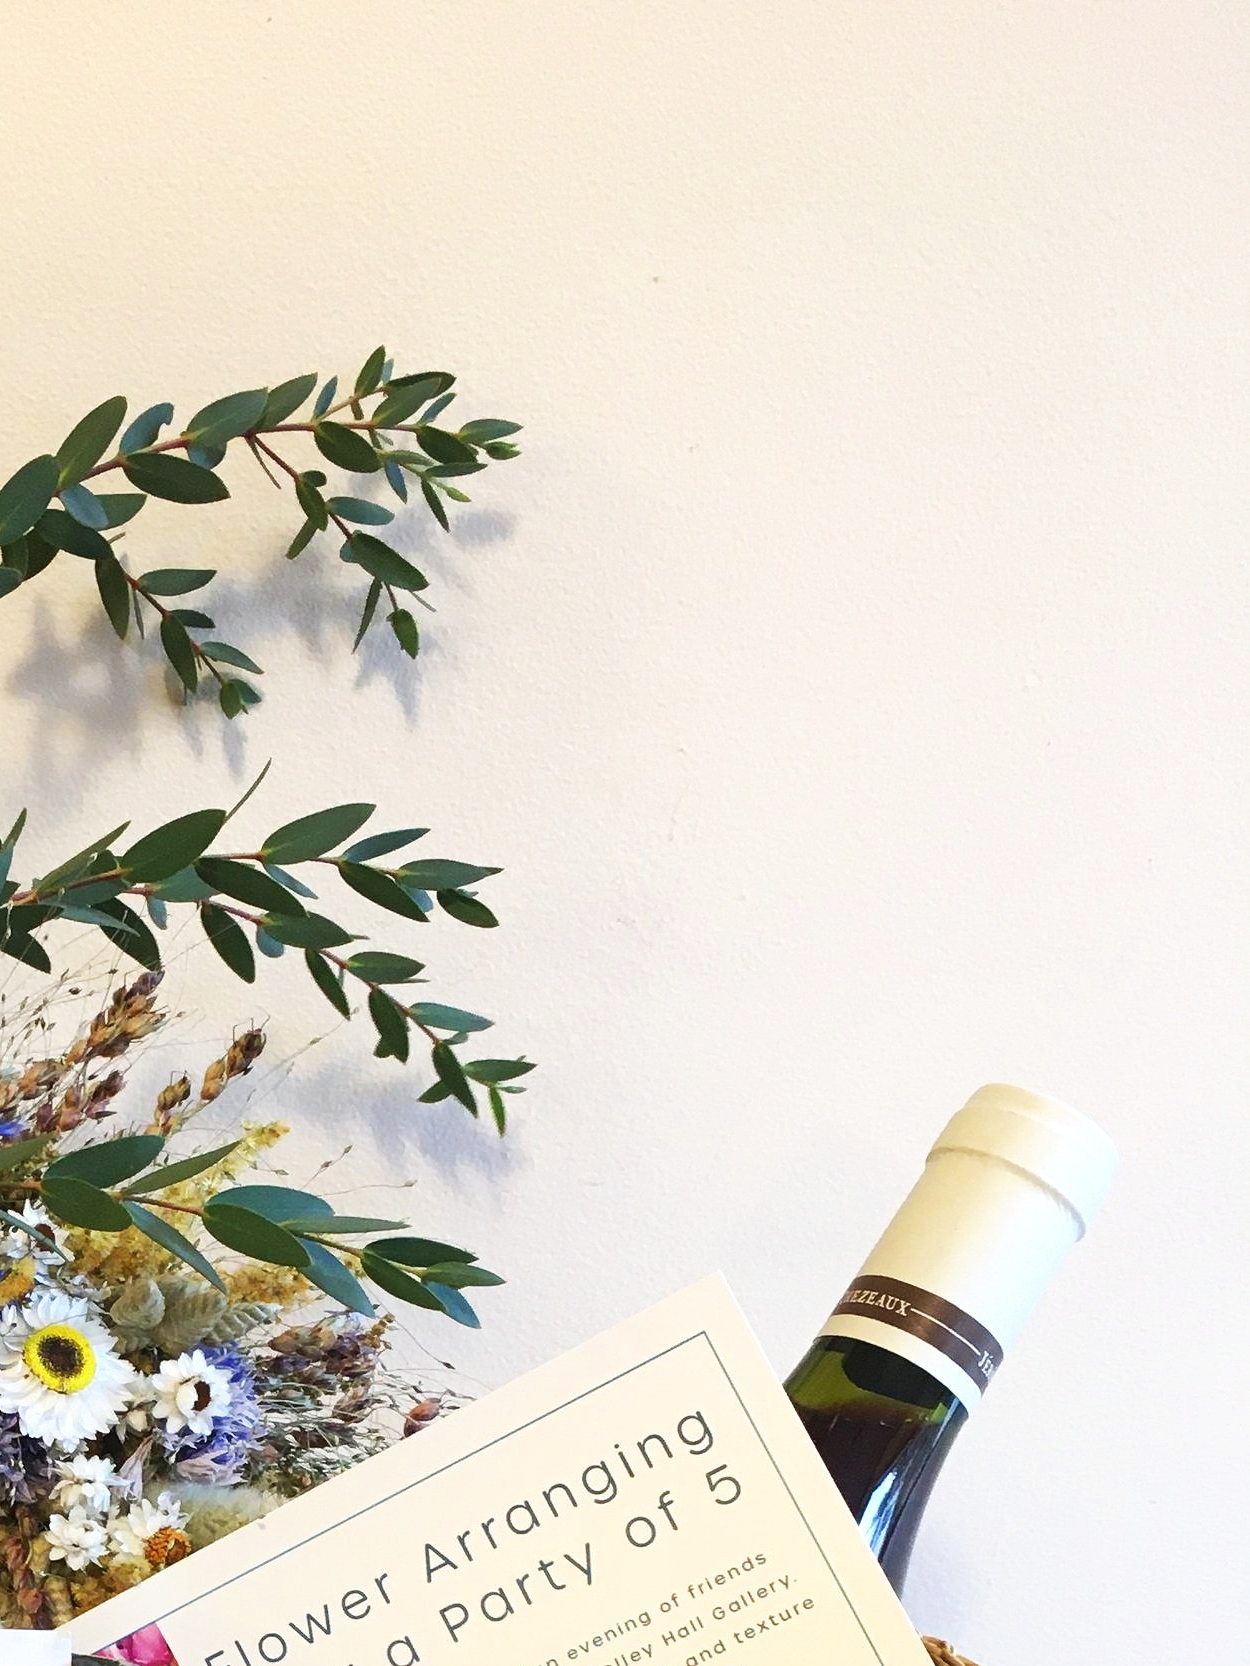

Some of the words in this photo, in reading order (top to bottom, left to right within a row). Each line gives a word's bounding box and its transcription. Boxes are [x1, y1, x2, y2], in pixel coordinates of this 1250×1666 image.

[840, 1289, 912, 1317] EZEAUX
[424, 1410, 714, 1584] Arranging
[438, 1541, 593, 1644] Party
[624, 1489, 679, 1548] of
[705, 1463, 742, 1506] 5
[566, 1611, 652, 1660] evening
[659, 1592, 680, 1614] of
[687, 1553, 767, 1600] friends
[661, 1615, 704, 1647] Hall
[711, 1574, 797, 1621] Gallery.
[733, 1598, 815, 1644] texture
